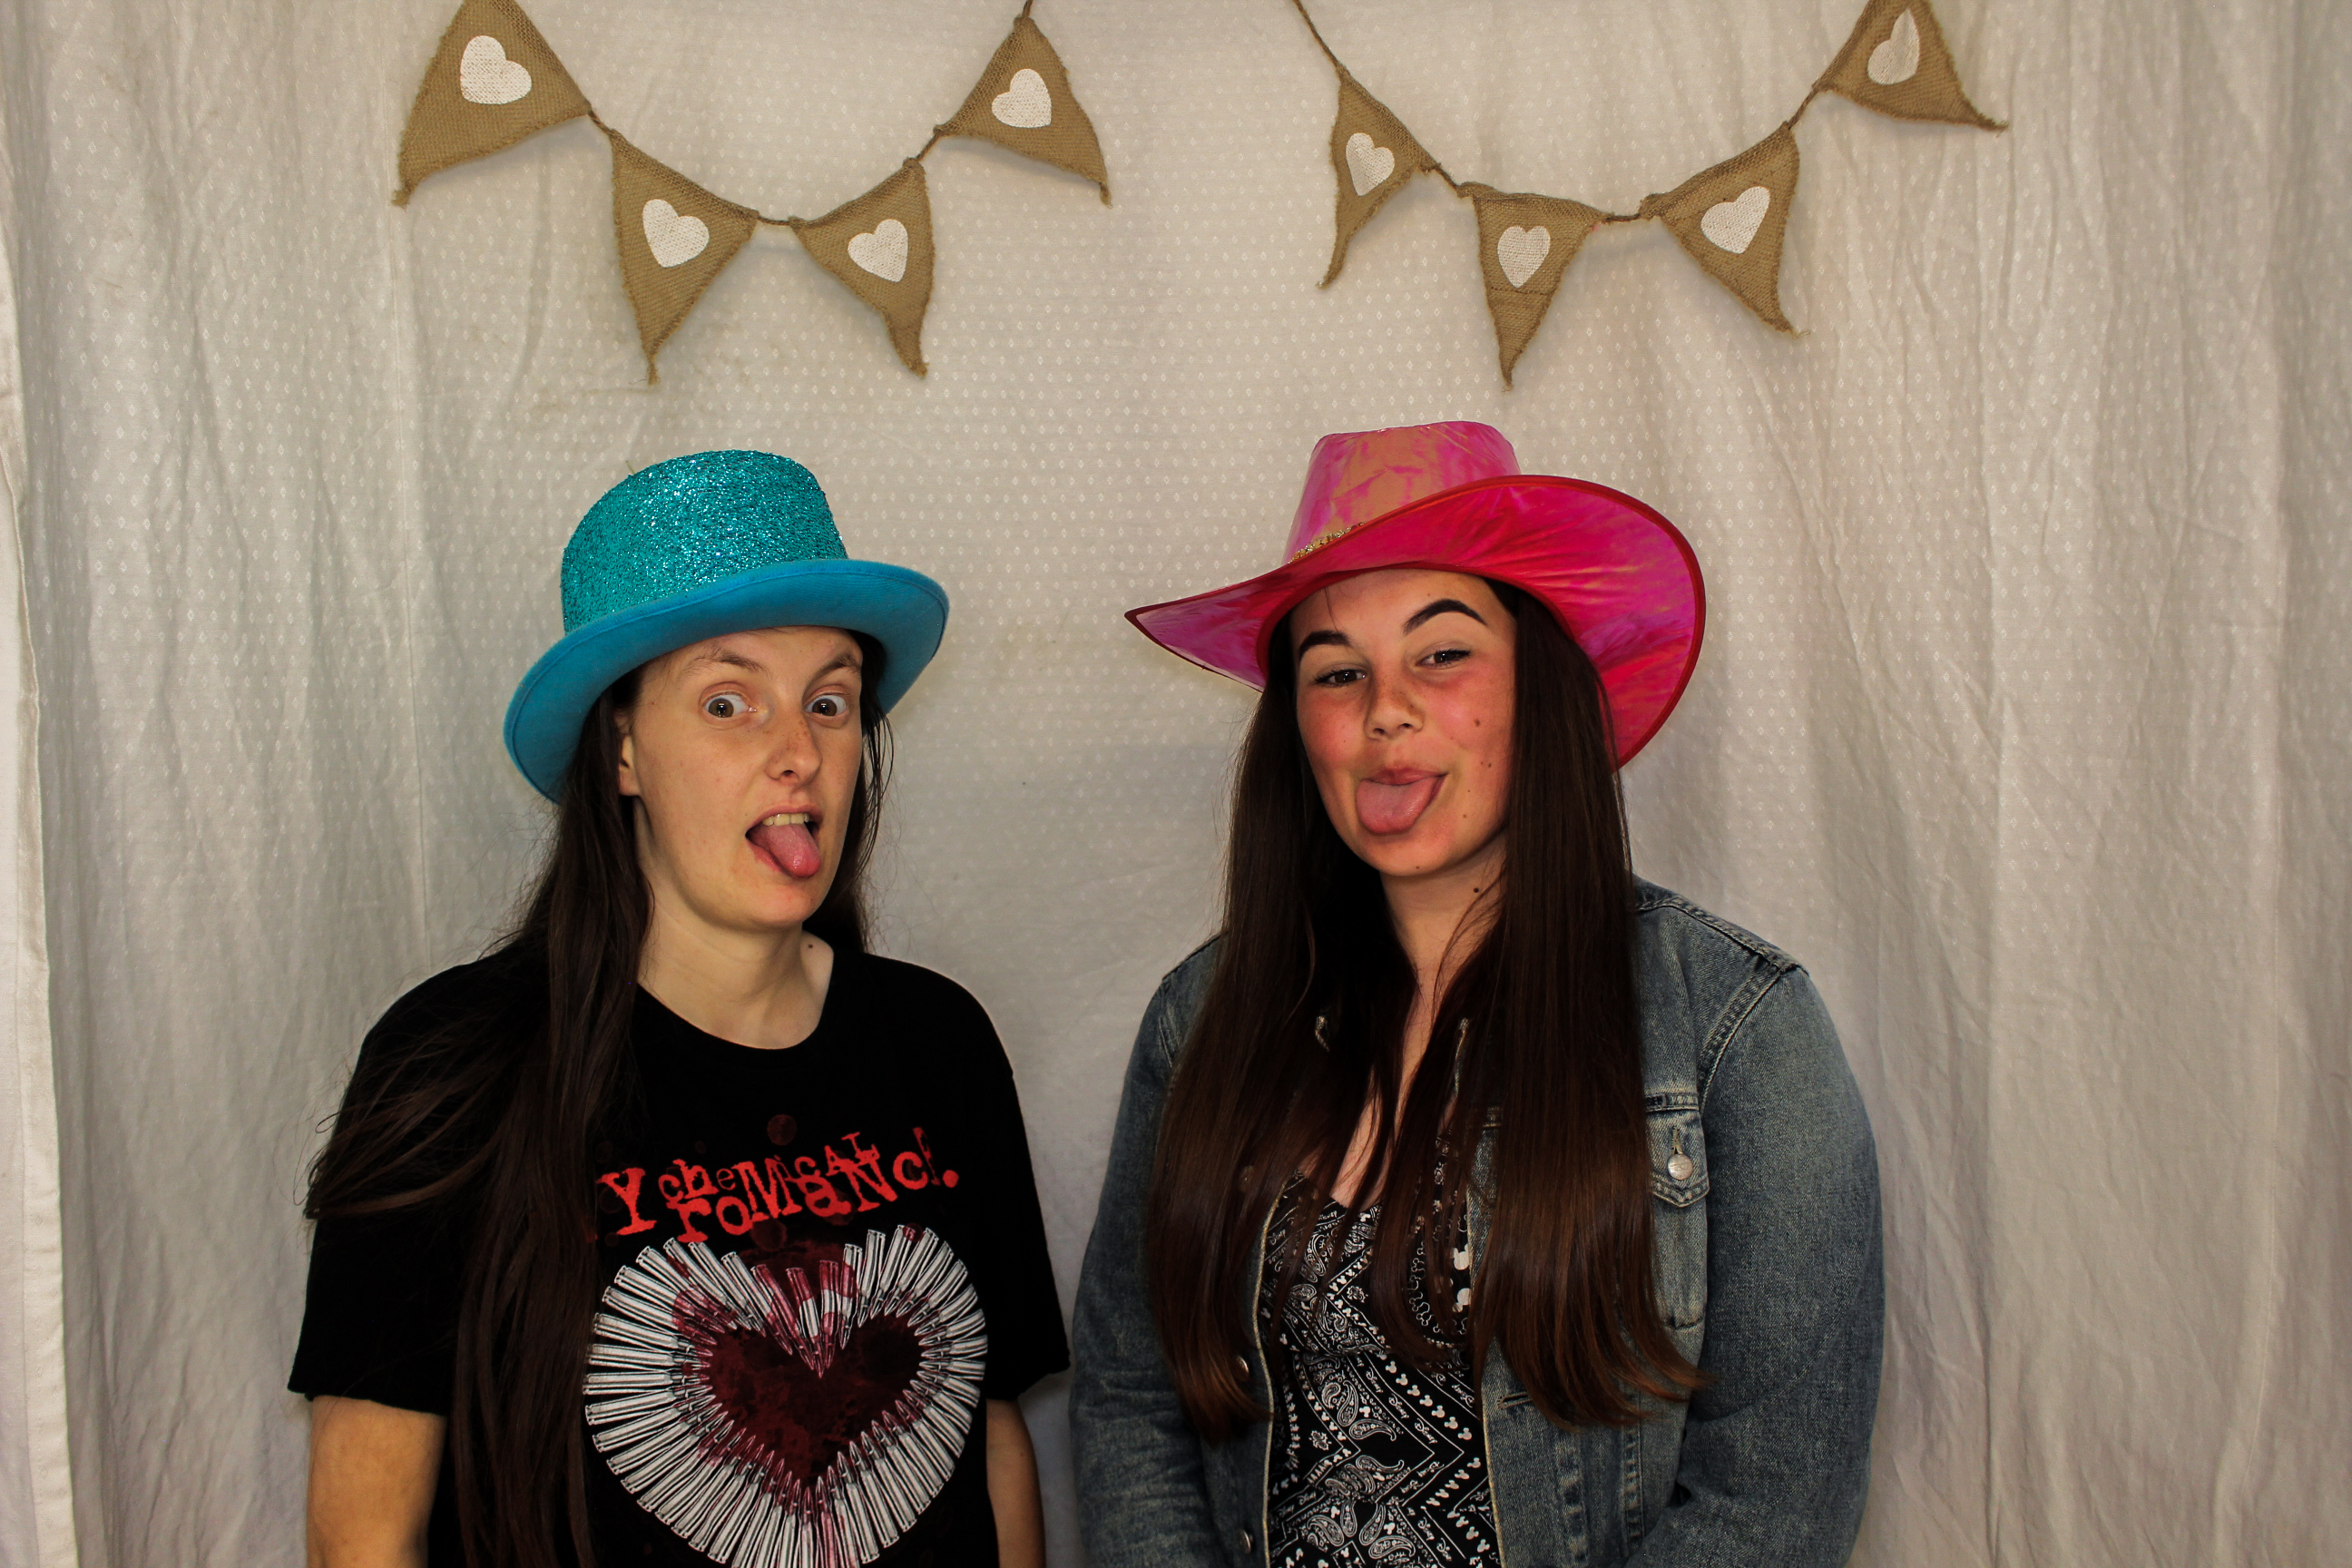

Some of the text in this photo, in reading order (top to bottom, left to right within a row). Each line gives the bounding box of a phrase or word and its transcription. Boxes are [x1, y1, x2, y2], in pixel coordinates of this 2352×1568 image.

[595, 1167, 657, 1235] Y
[1366, 1367, 1438, 1445] Disney Disney Disney
[1451, 1384, 1475, 1408] Disney
[1399, 1461, 1445, 1494] Disney Disney
